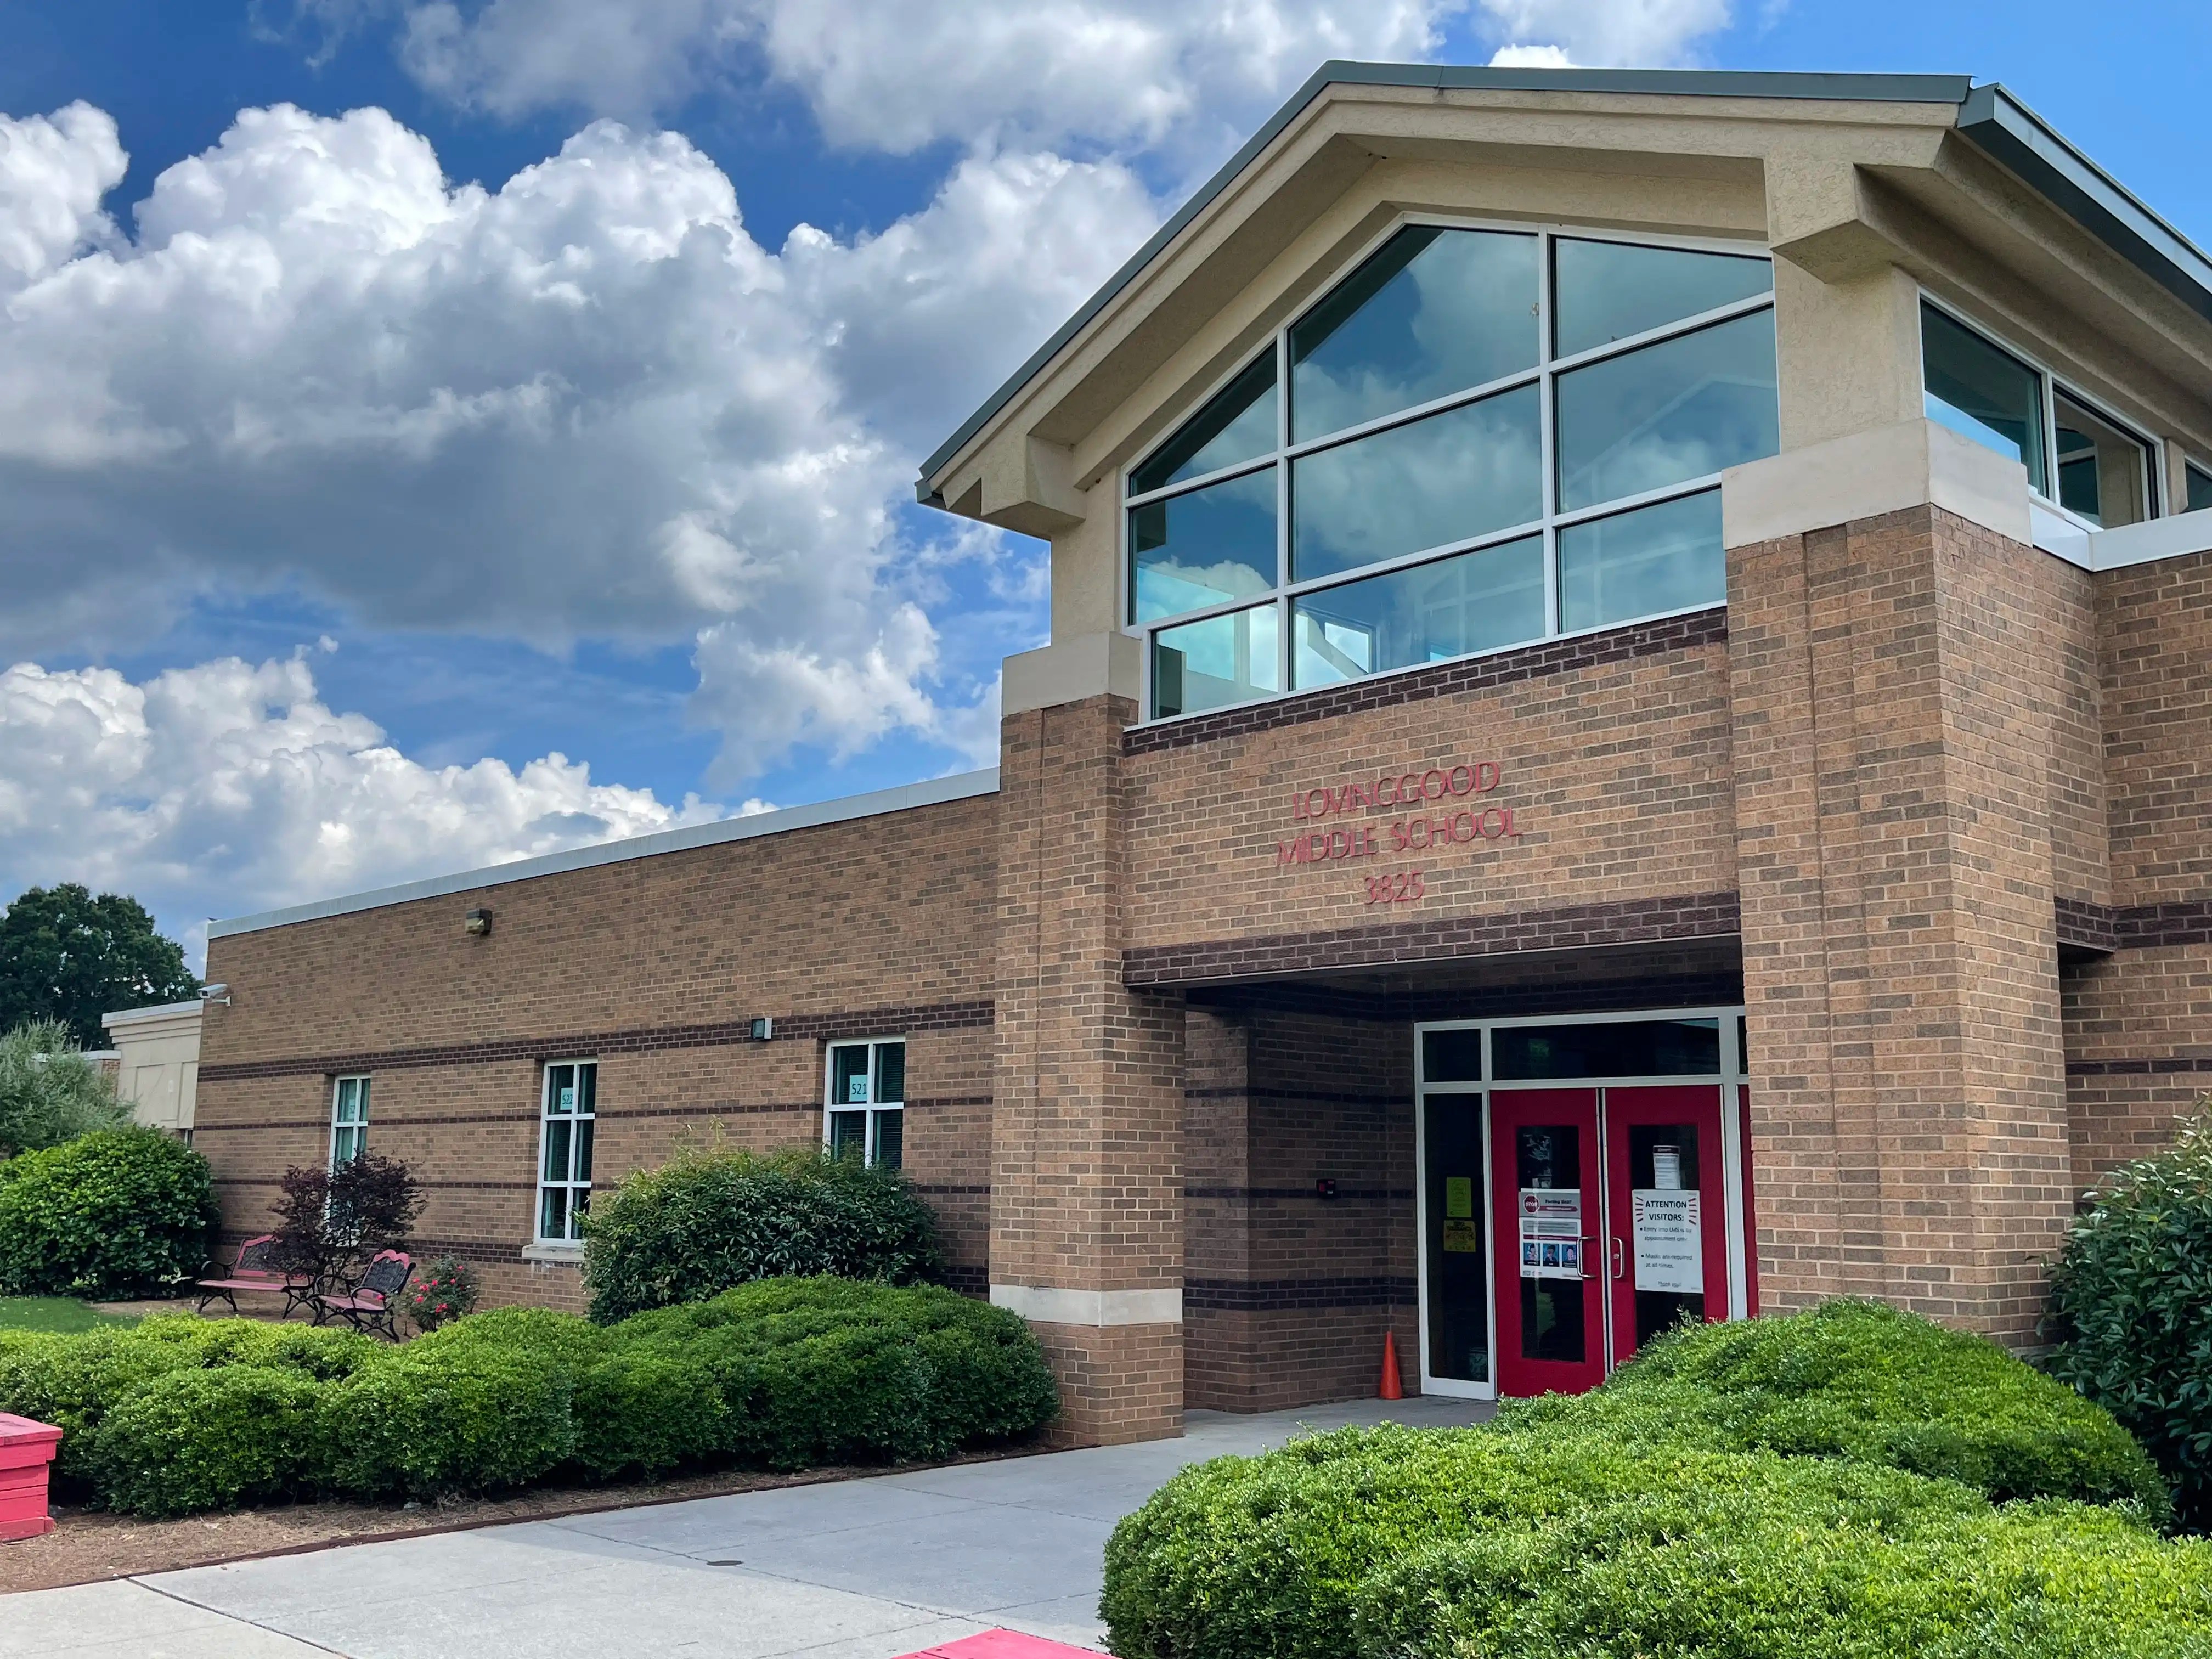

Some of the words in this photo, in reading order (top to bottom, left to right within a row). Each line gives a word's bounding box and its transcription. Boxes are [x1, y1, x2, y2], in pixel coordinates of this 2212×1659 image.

[1293, 761, 1500, 820] LOVINGGOOD
[1277, 826, 1376, 866] MIDDLE
[1391, 807, 1523, 851] SCHOOL
[1364, 870, 1425, 905] 3825
[851, 1083, 867, 1095] 521
[1645, 1200, 1687, 1209] ATTENTION
[1649, 1213, 1684, 1221] VISITORS:
